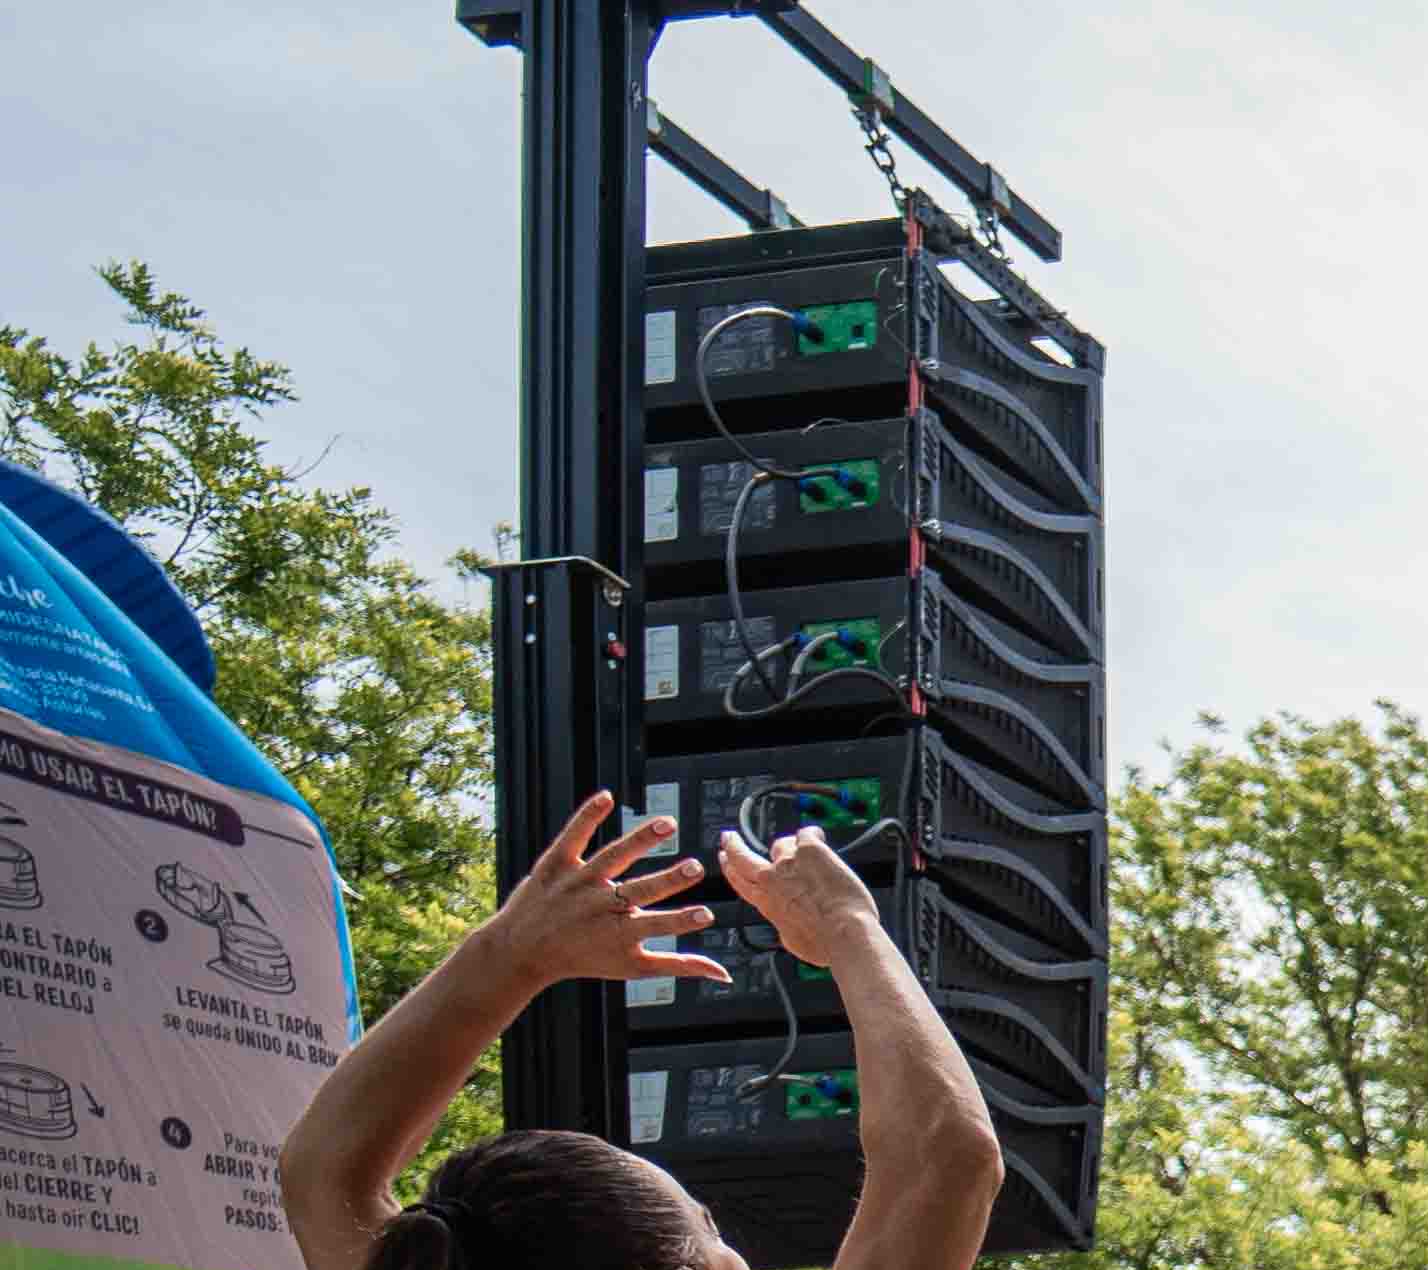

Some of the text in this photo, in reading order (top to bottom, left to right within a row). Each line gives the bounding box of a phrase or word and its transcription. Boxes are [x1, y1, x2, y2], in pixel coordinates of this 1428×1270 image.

[32, 752, 97, 792] USAR
[103, 775, 134, 803] EL
[136, 784, 217, 830] TAPÓN?
[24, 927, 46, 949] EL
[52, 932, 113, 966] TAPÓN
[34, 985, 94, 1014] RELOJ
[176, 986, 250, 1023] LEVANTA
[253, 1007, 272, 1028] EL
[162, 1012, 181, 1030] se
[186, 1020, 231, 1043] queda
[235, 1026, 281, 1055] UNIDO
[286, 1040, 304, 1061] AL
[224, 1132, 257, 1156] Para
[62, 1154, 77, 1173] el
[83, 1156, 141, 1184] TAPÓN
[203, 1154, 254, 1184] ABRIR
[259, 1167, 268, 1183] Y
[25, 1173, 96, 1203] CIERRE
[102, 1185, 112, 1204] Y
[6, 1200, 56, 1225] hasta
